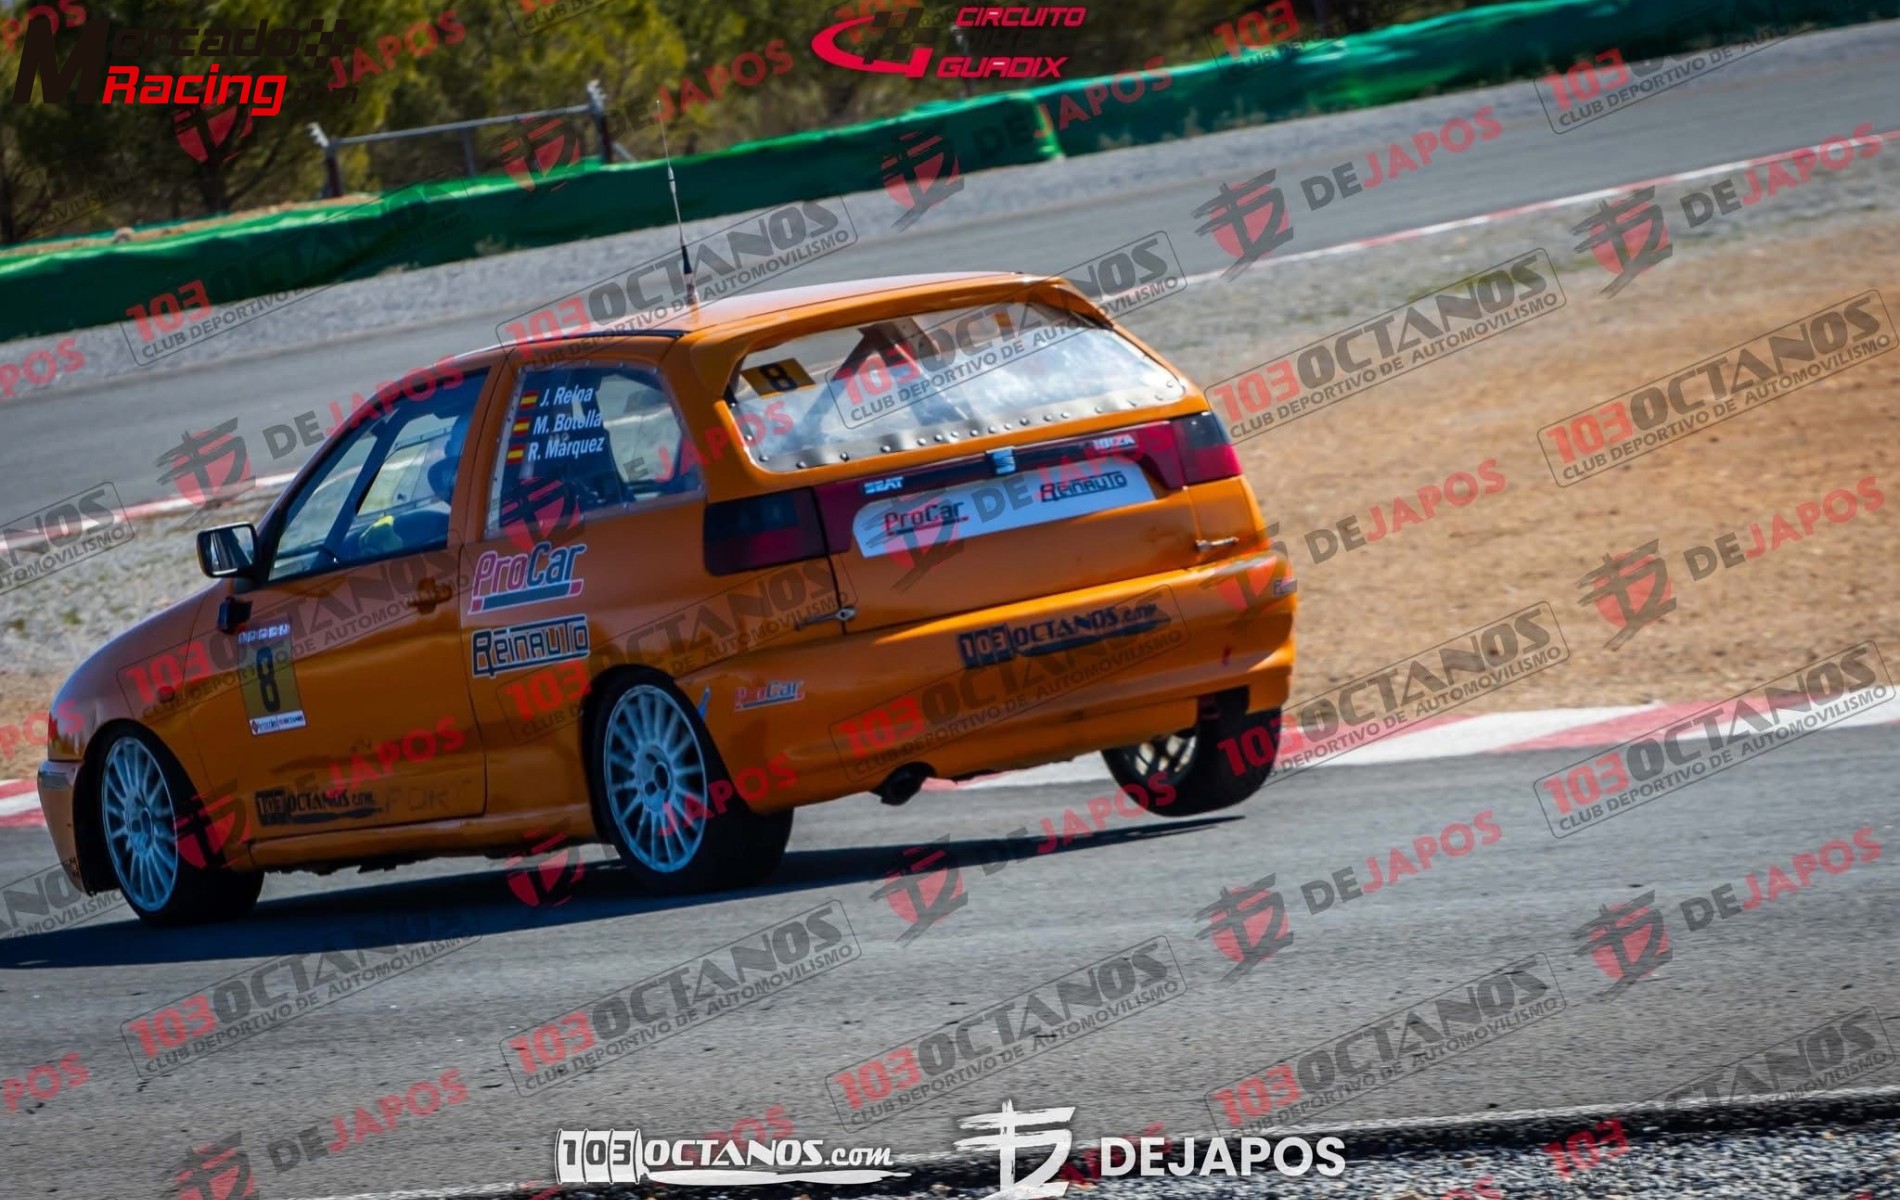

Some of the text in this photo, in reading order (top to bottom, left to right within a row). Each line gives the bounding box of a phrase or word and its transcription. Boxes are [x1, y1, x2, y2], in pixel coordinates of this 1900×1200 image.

[758, 363, 797, 392] 8
[553, 384, 594, 406] Reina
[533, 415, 549, 435] M.
[528, 442, 541, 461] R.
[863, 476, 904, 495] SEAT
[884, 501, 965, 532] ProCar
[471, 541, 588, 602] ProCar
[256, 646, 281, 713] 8
